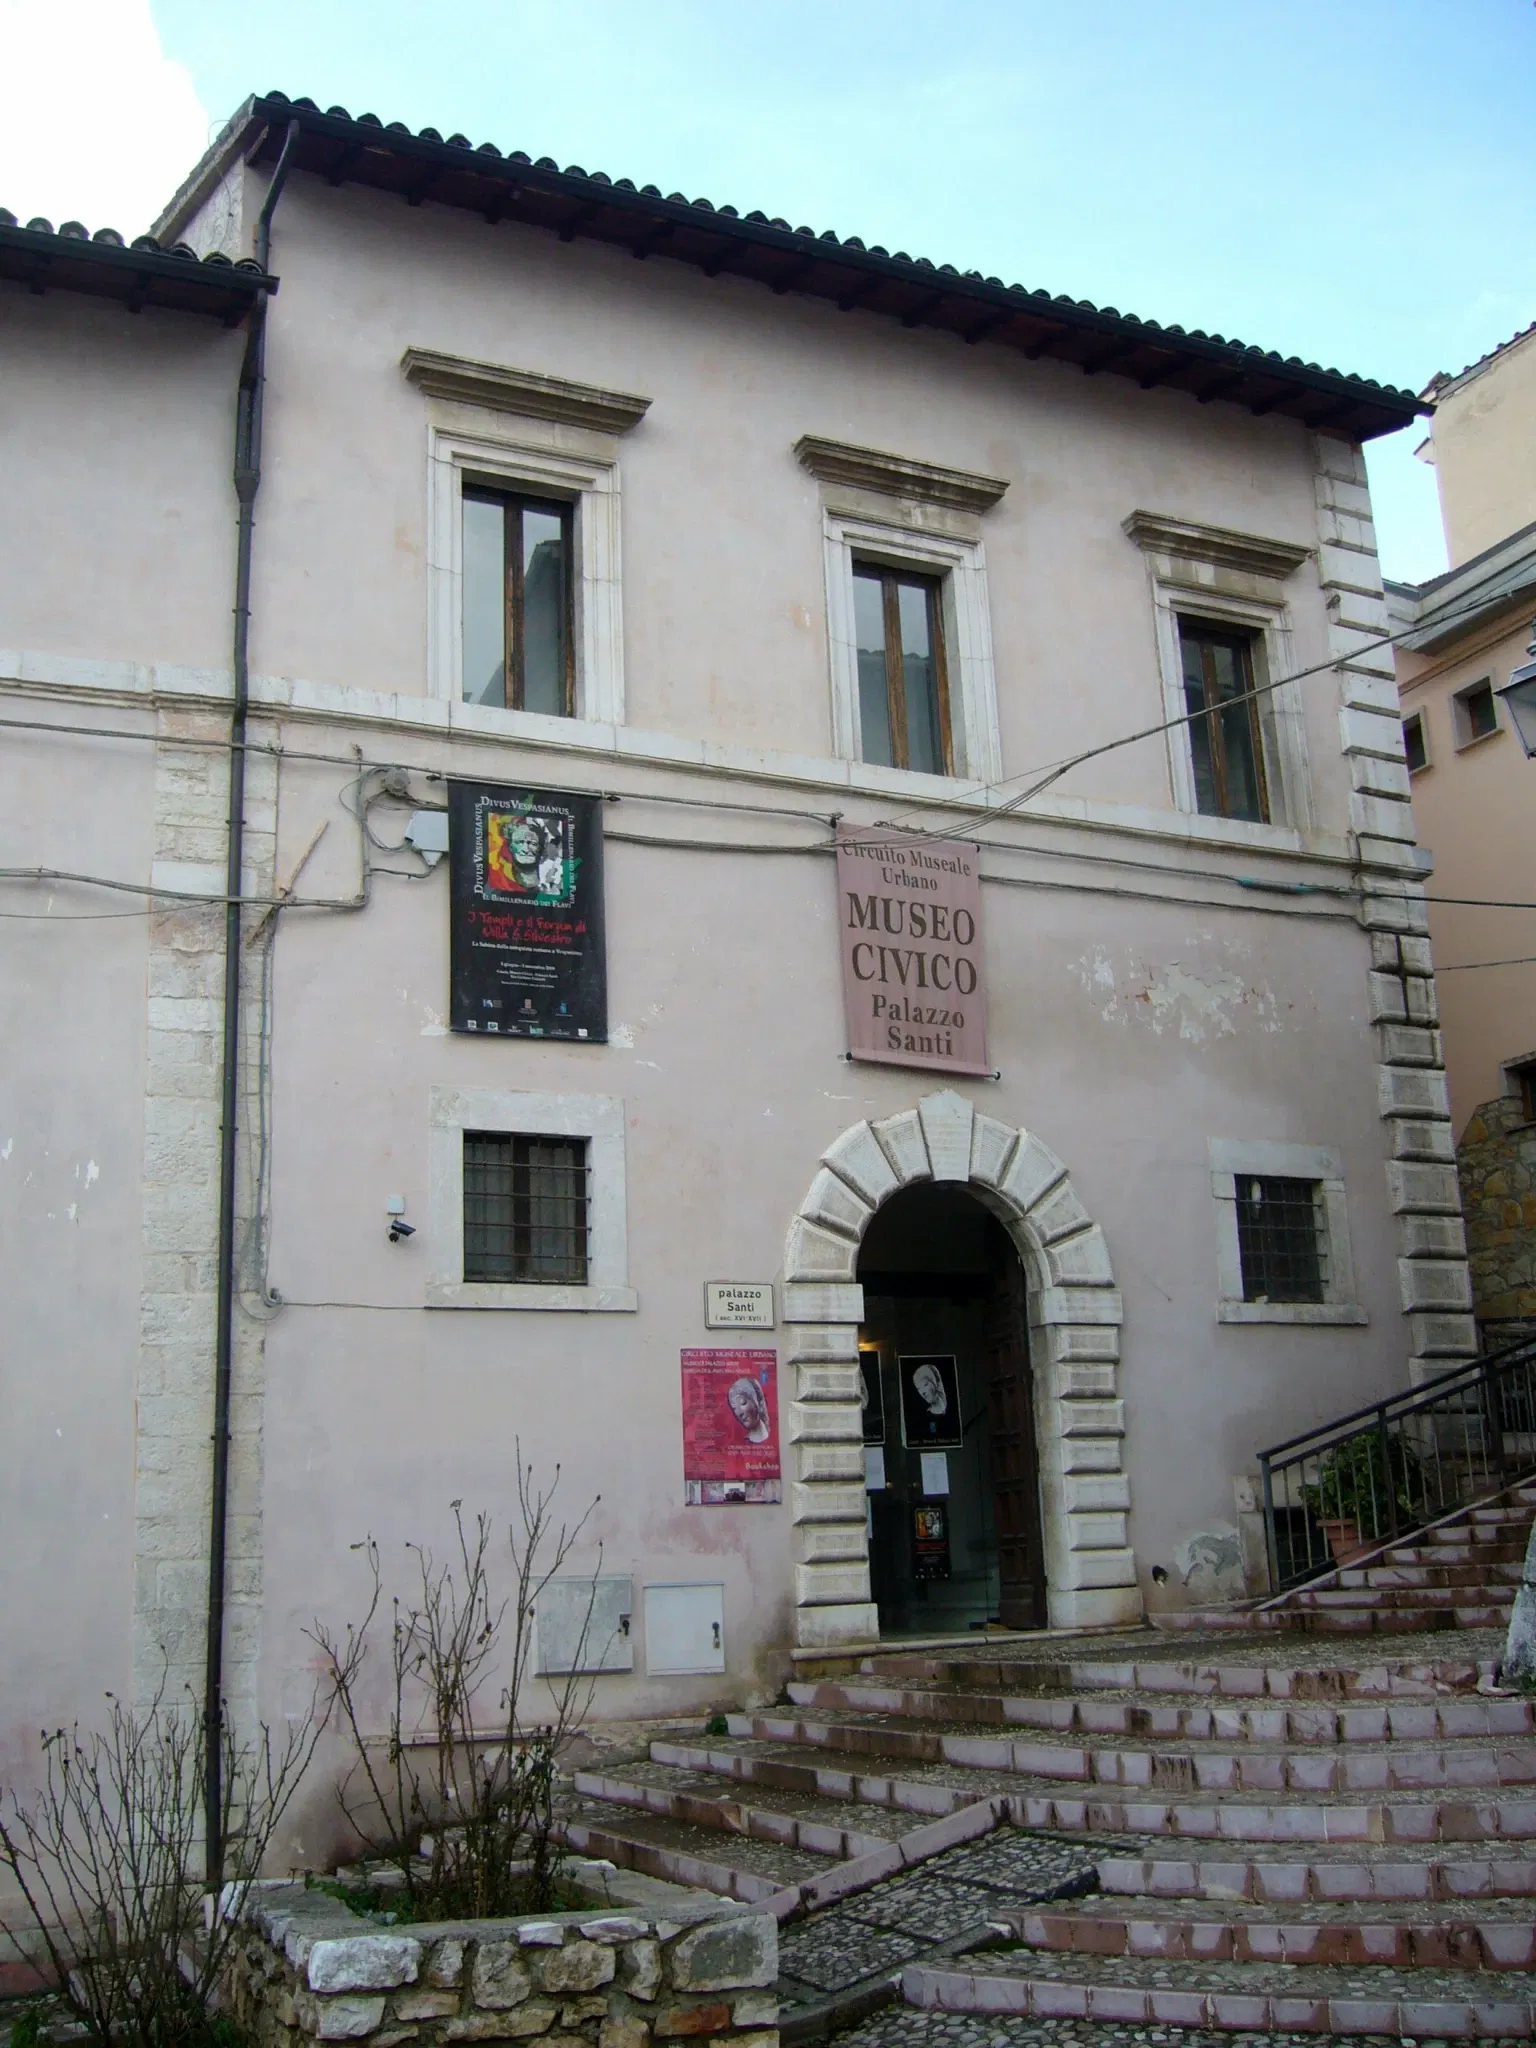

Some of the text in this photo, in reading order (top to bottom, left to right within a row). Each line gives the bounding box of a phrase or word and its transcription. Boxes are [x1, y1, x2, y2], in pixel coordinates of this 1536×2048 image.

[841, 839, 972, 877] Circuito Museale
[881, 867, 938, 891] Urbano
[846, 892, 976, 946] MUSEO
[852, 942, 977, 995] CIVICO
[871, 993, 965, 1029] Palazzo
[887, 1025, 954, 1056] Santi
[718, 1288, 762, 1299] palazzo
[727, 1302, 755, 1312] Santi
